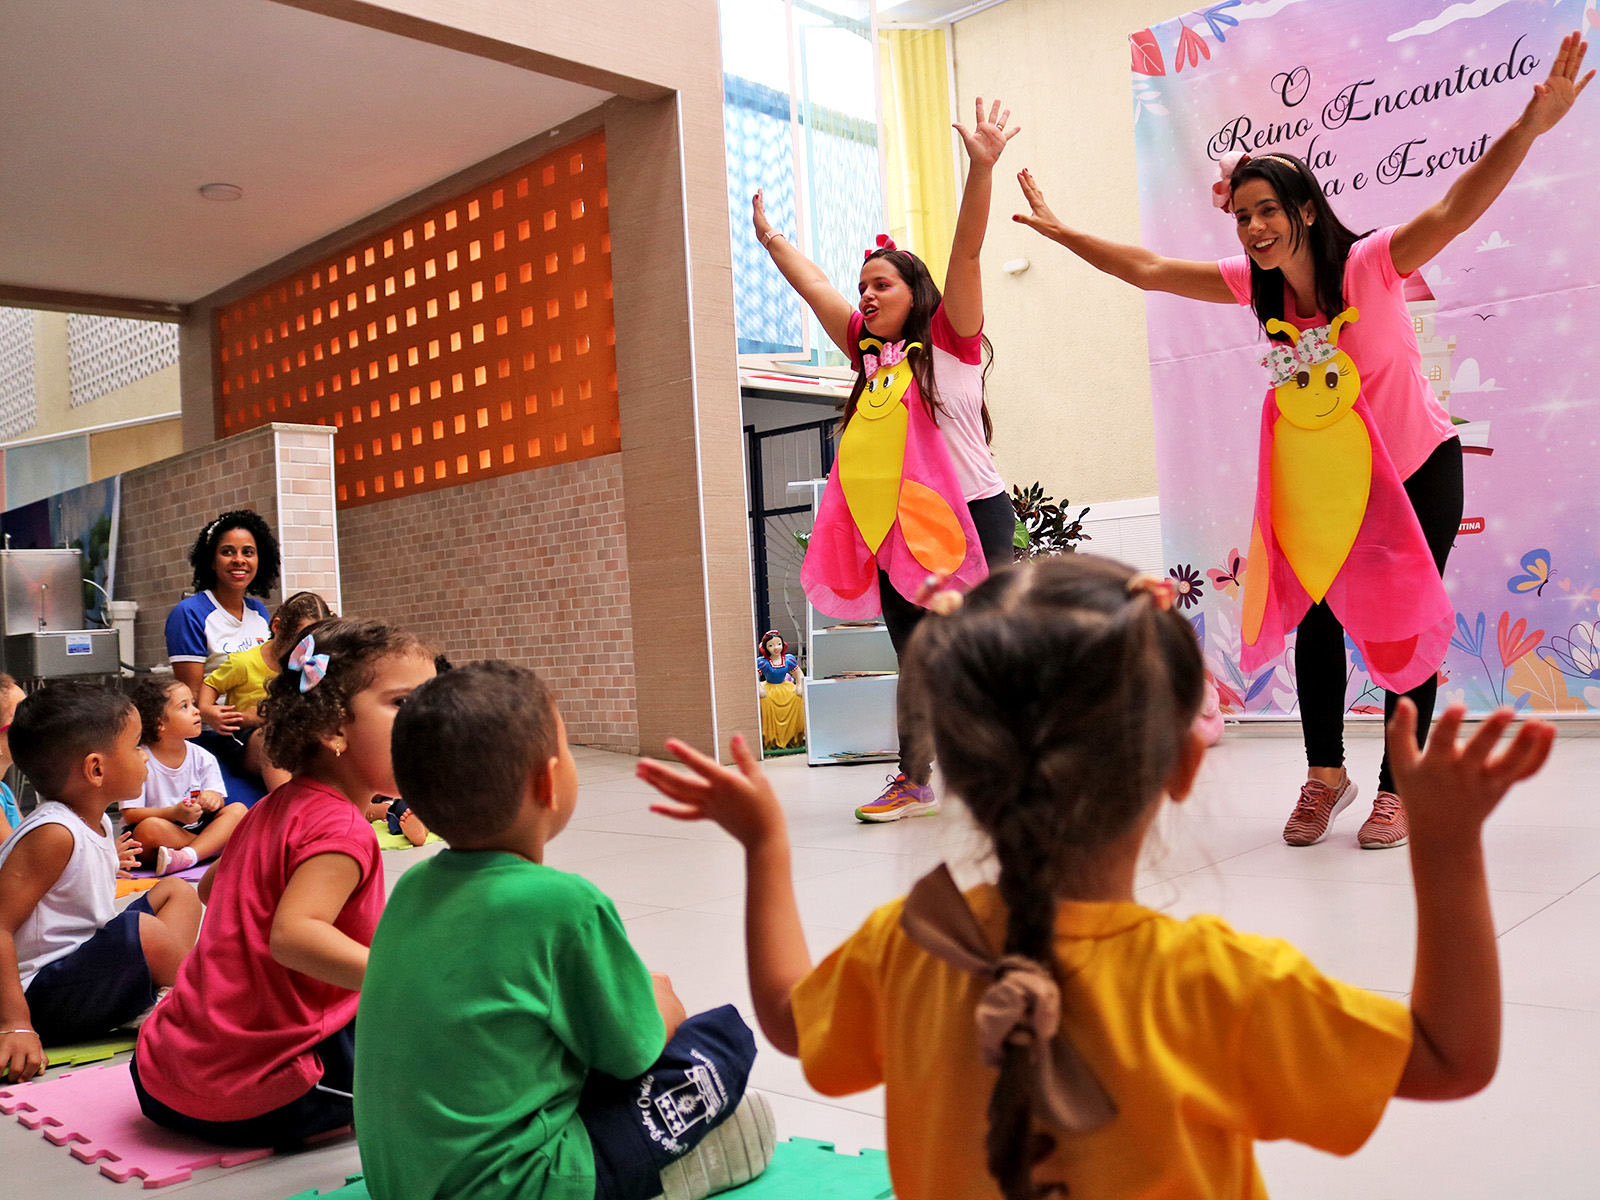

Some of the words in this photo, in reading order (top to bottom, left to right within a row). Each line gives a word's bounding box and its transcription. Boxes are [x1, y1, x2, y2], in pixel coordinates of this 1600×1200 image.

[1206, 113, 1313, 161] Reino
[1321, 33, 1541, 130] Encantado
[1270, 65, 1311, 108] O
[1300, 133, 1337, 172] da
[1352, 171, 1369, 191] e
[642, 1110, 665, 1142] Padre
